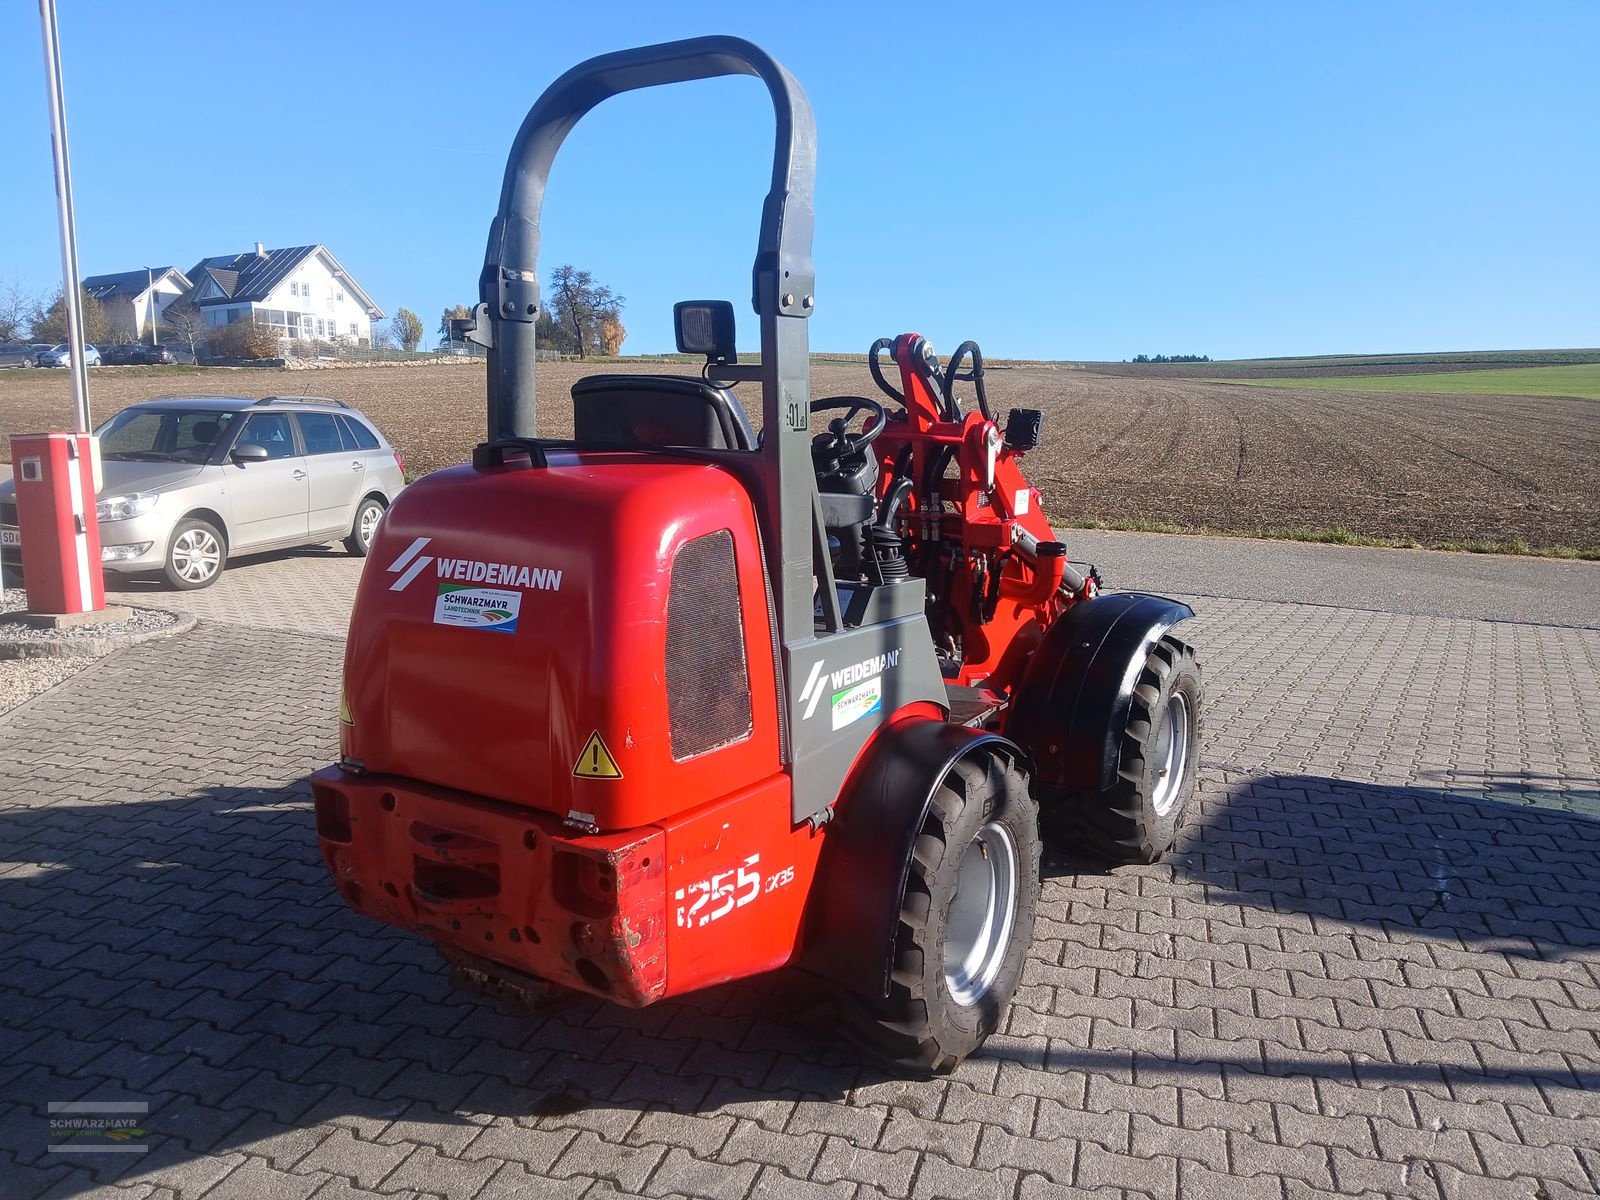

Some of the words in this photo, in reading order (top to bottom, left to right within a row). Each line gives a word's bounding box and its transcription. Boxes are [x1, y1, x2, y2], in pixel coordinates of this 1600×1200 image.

[436, 557, 563, 591] WEIDEMANN
[443, 605, 481, 615] LANDTECHNIK
[444, 594, 508, 610] SCHWARZMAYR
